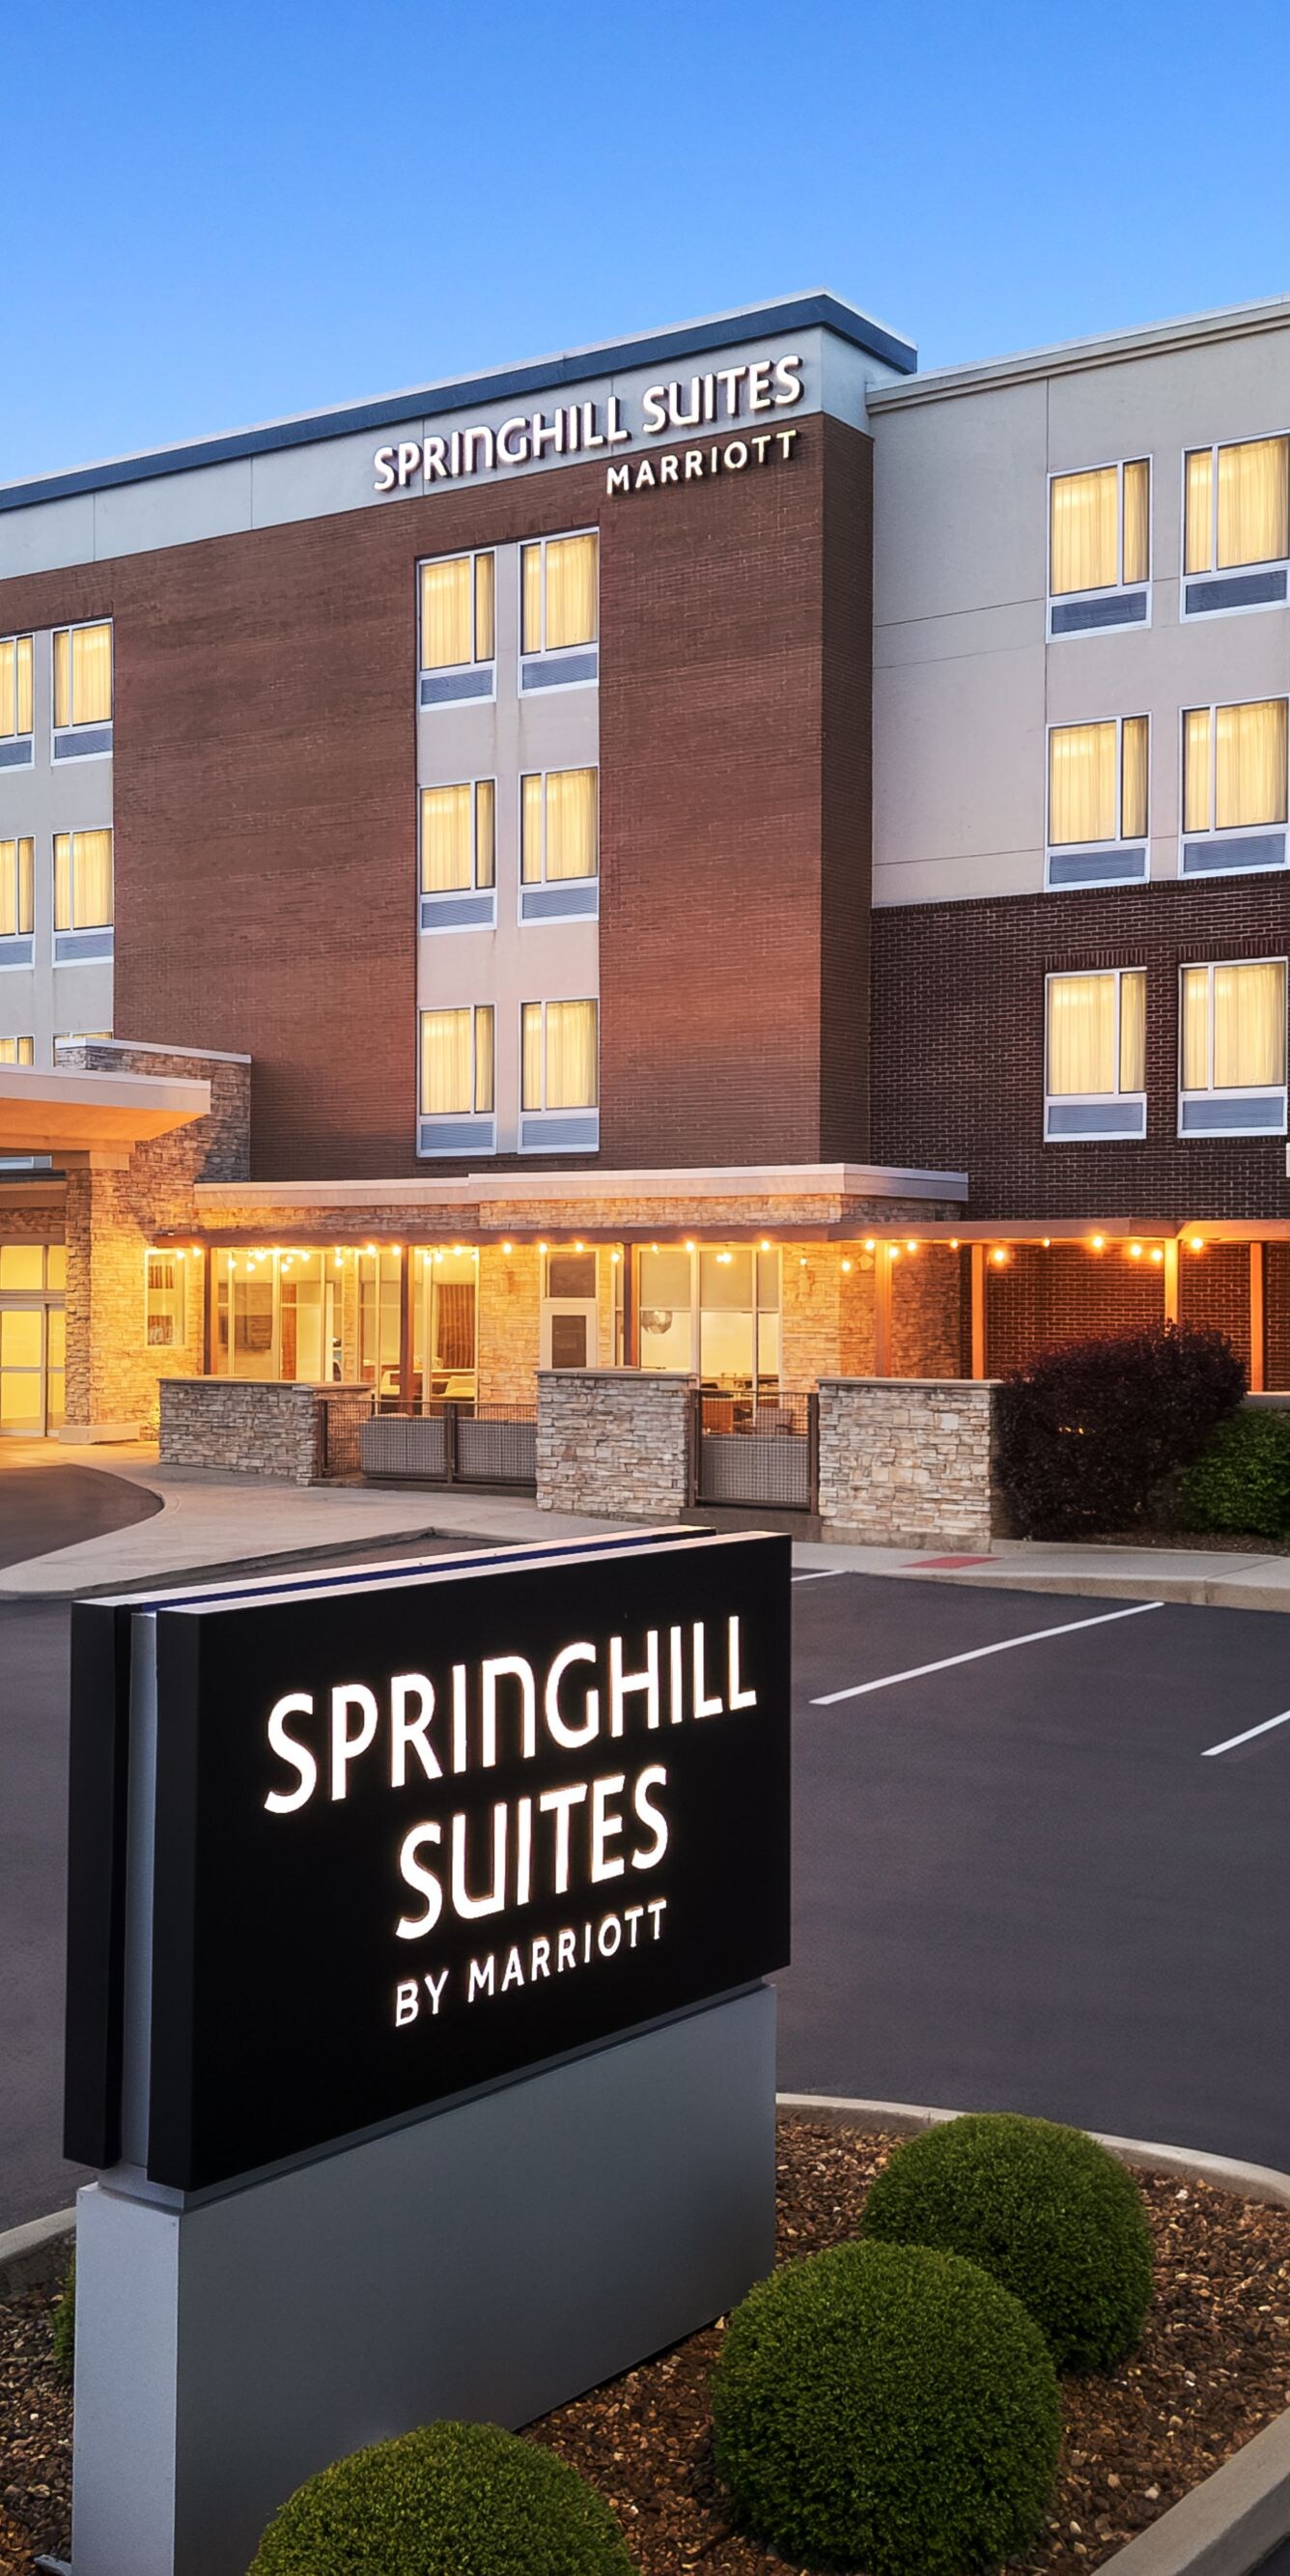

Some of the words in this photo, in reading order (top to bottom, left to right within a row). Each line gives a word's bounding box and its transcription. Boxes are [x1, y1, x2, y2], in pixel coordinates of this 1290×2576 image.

[642, 354, 804, 434] SUITES
[606, 429, 799, 495] MARRIOTT
[395, 1765, 669, 1939] SUITES
[395, 1969, 449, 2027] BY
[466, 1899, 667, 2003] MARRIOTT
